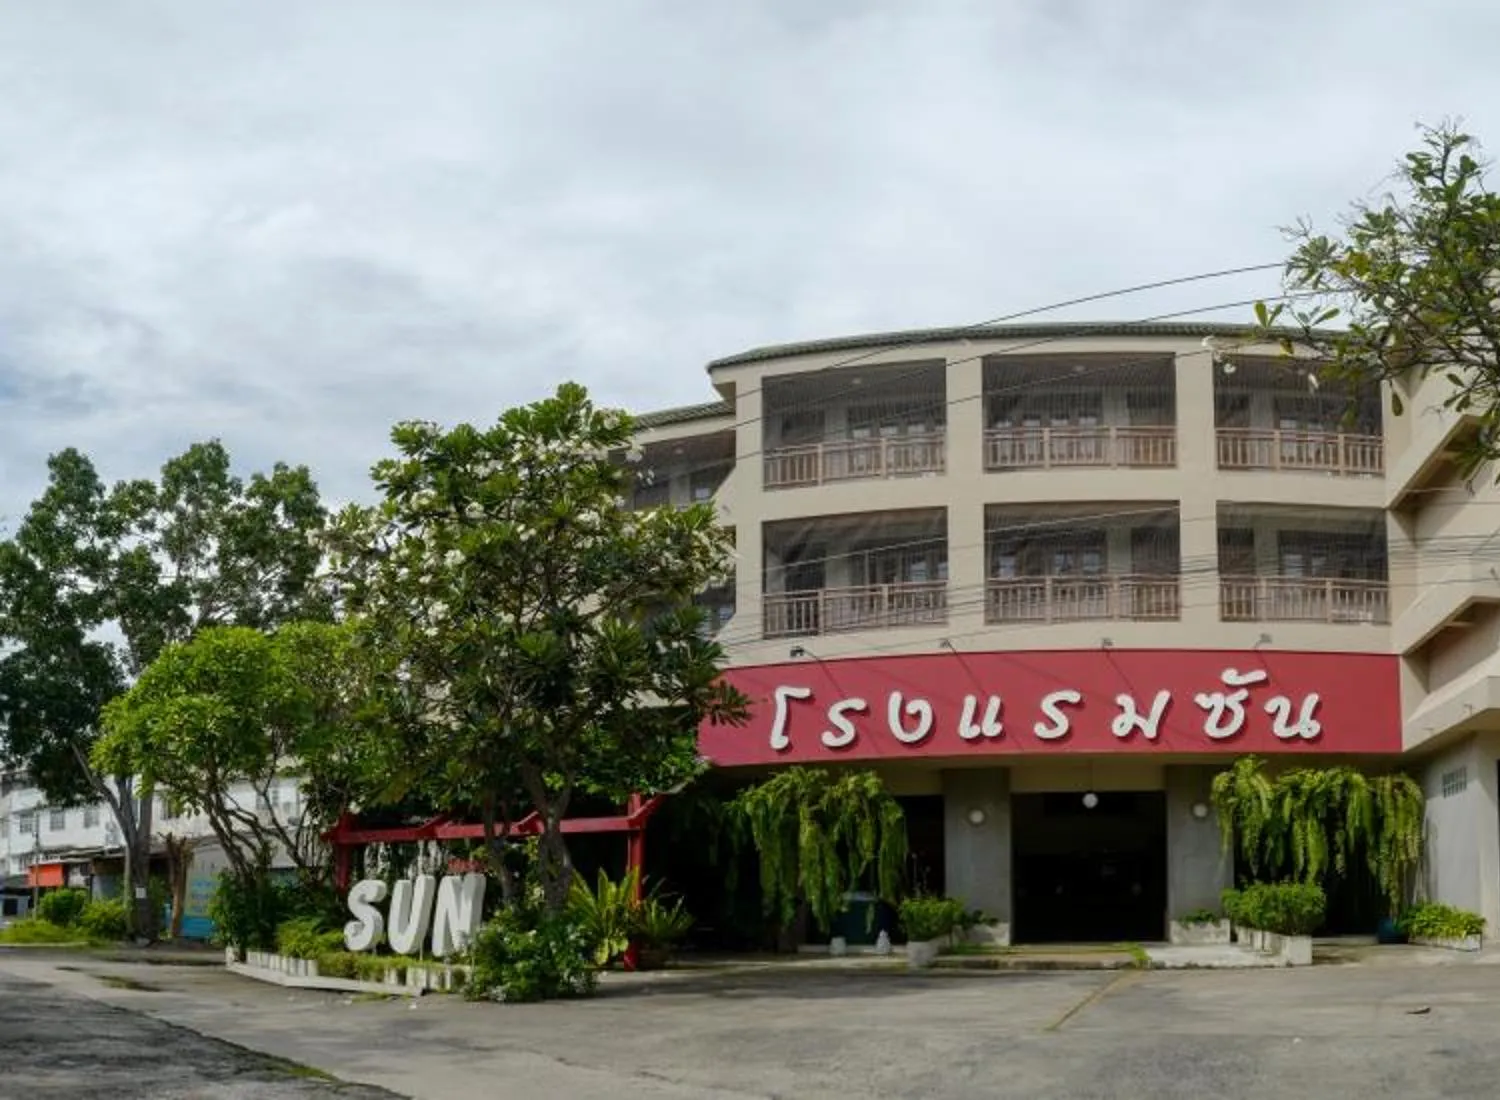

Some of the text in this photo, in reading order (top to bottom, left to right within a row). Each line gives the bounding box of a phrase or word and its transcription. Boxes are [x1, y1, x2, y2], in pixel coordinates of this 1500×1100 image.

[770, 667, 1322, 750] โรงแรมซัน
[343, 873, 487, 957] SUN
